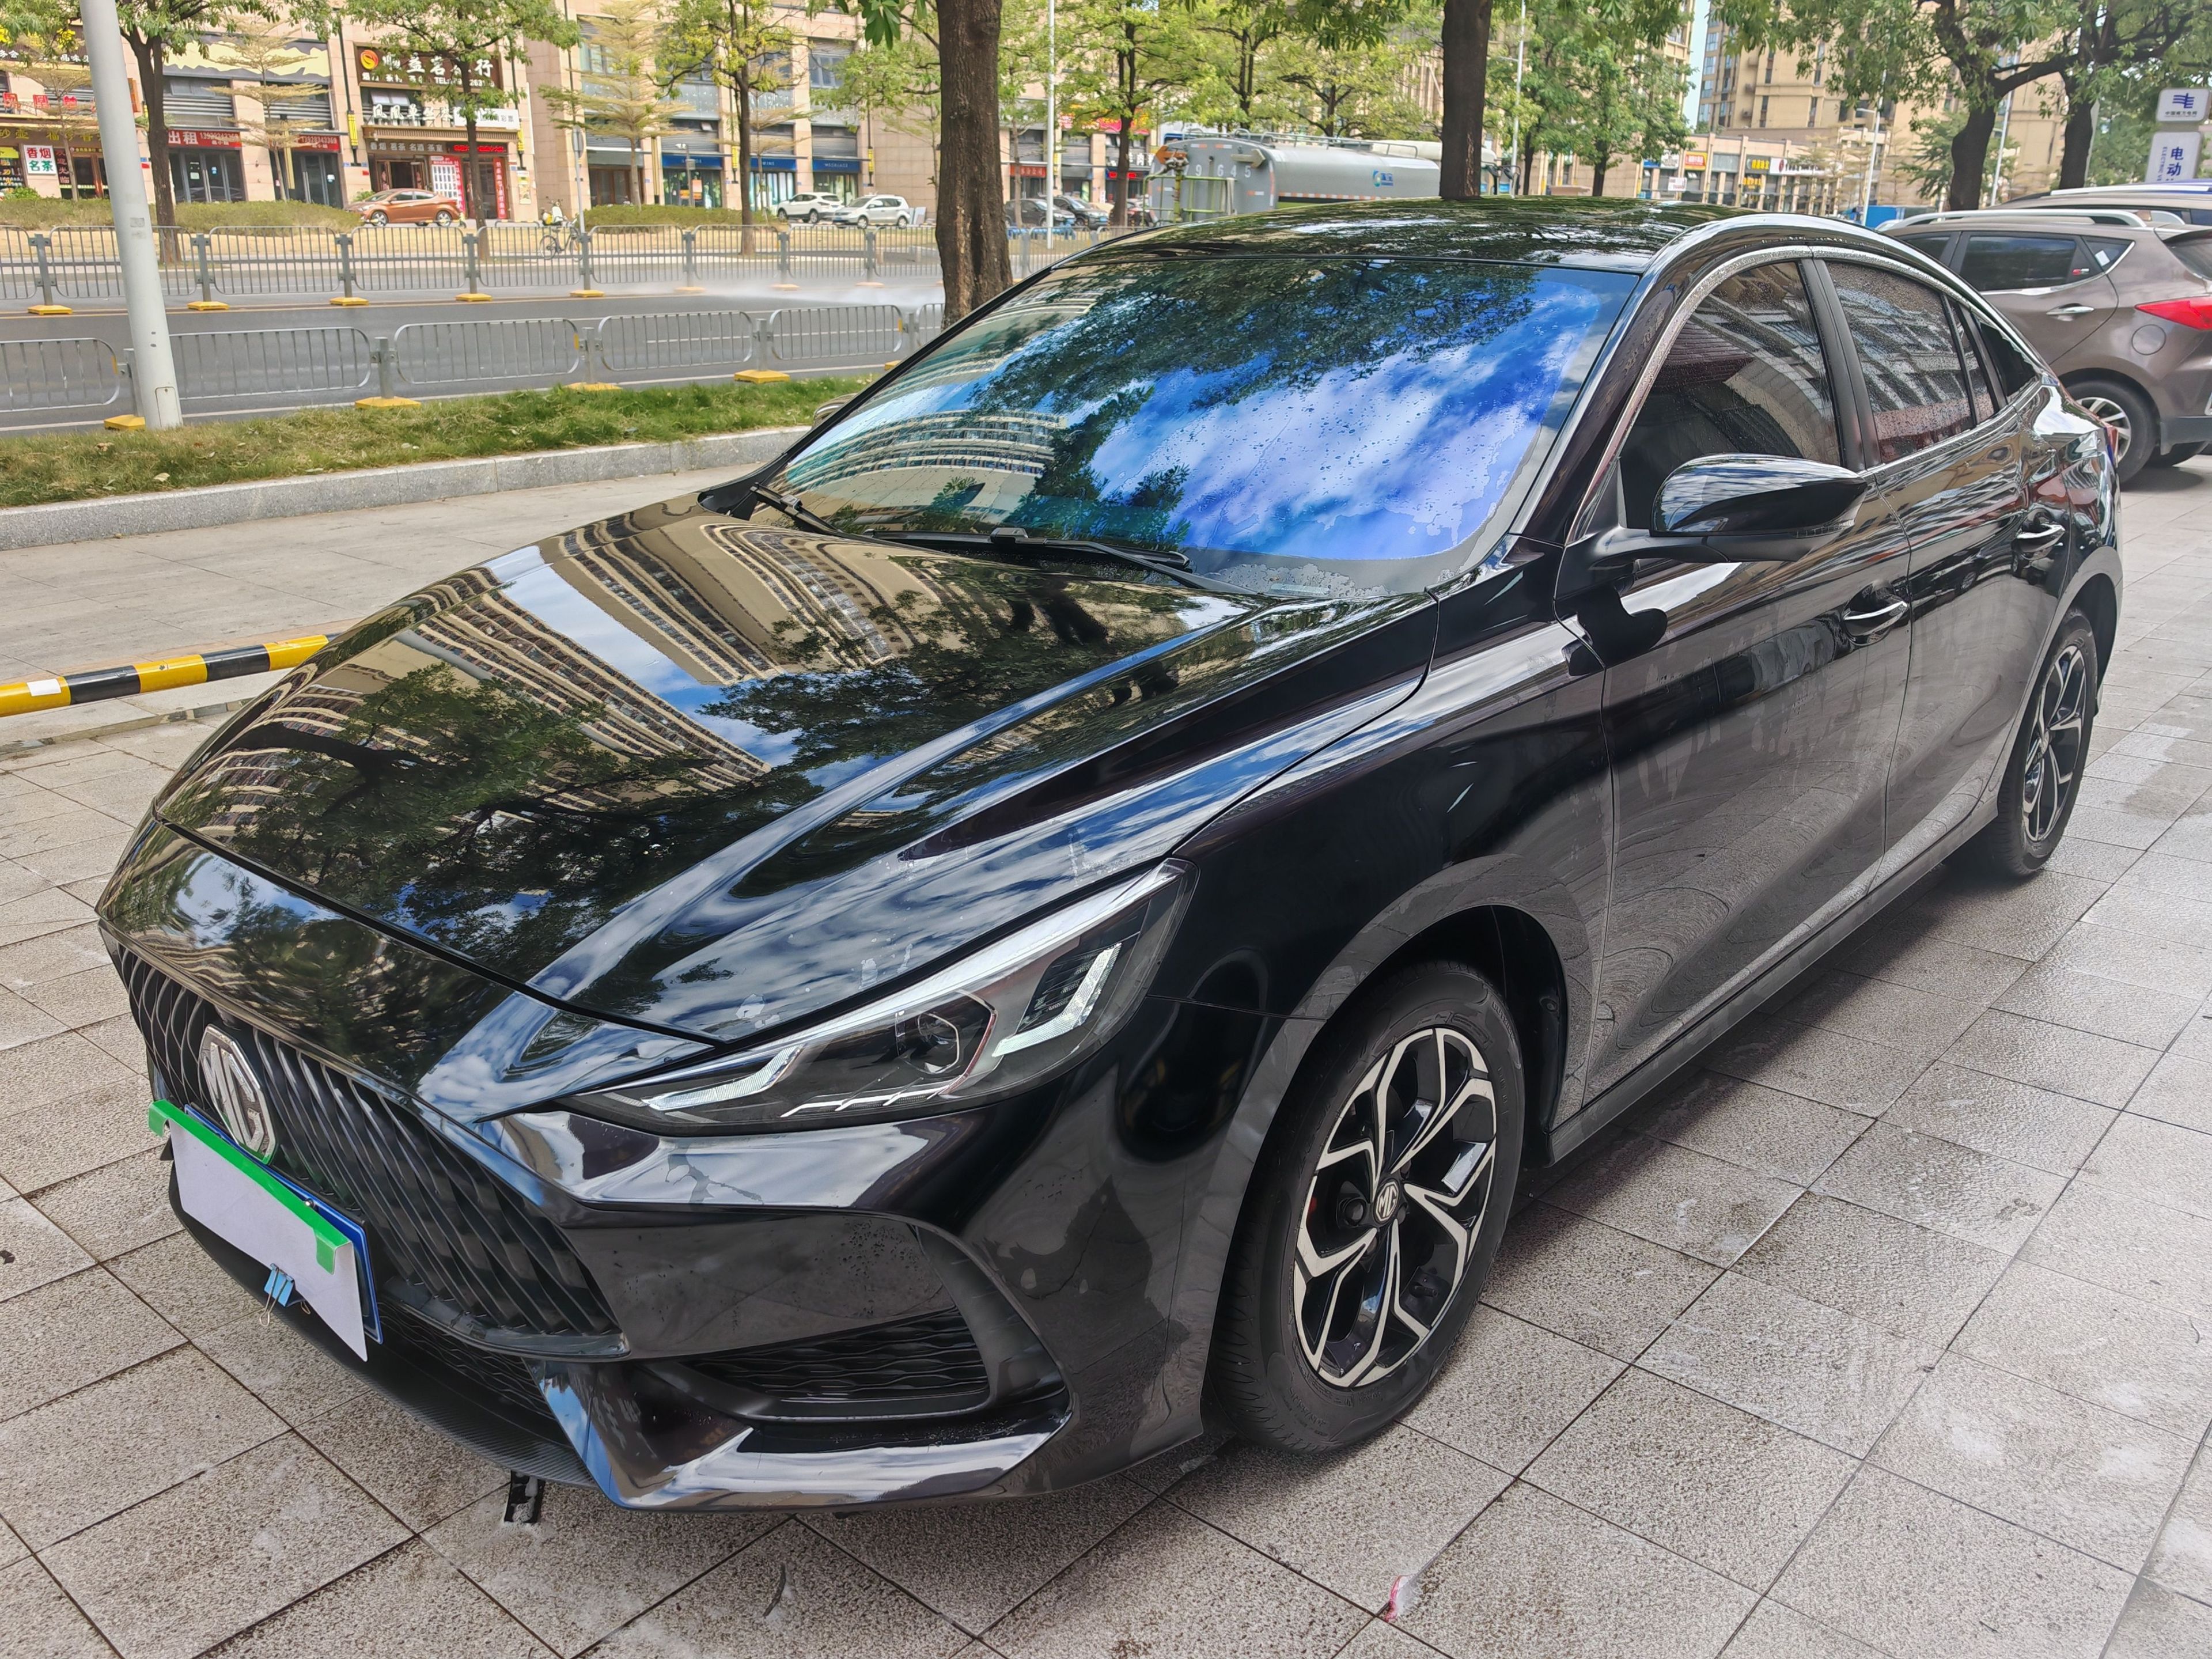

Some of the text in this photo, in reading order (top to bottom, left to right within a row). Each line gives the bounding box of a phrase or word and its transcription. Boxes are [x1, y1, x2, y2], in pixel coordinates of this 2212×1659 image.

[168, 131, 198, 145] 出租
[27, 147, 52, 159] 香烟
[29, 160, 54, 172] 名茶
[2158, 146, 2168, 173] ELECTRIC
[2165, 146, 2184, 181] 电动
[200, 1039, 268, 1156] MG
[1377, 1184, 1399, 1219] MG
